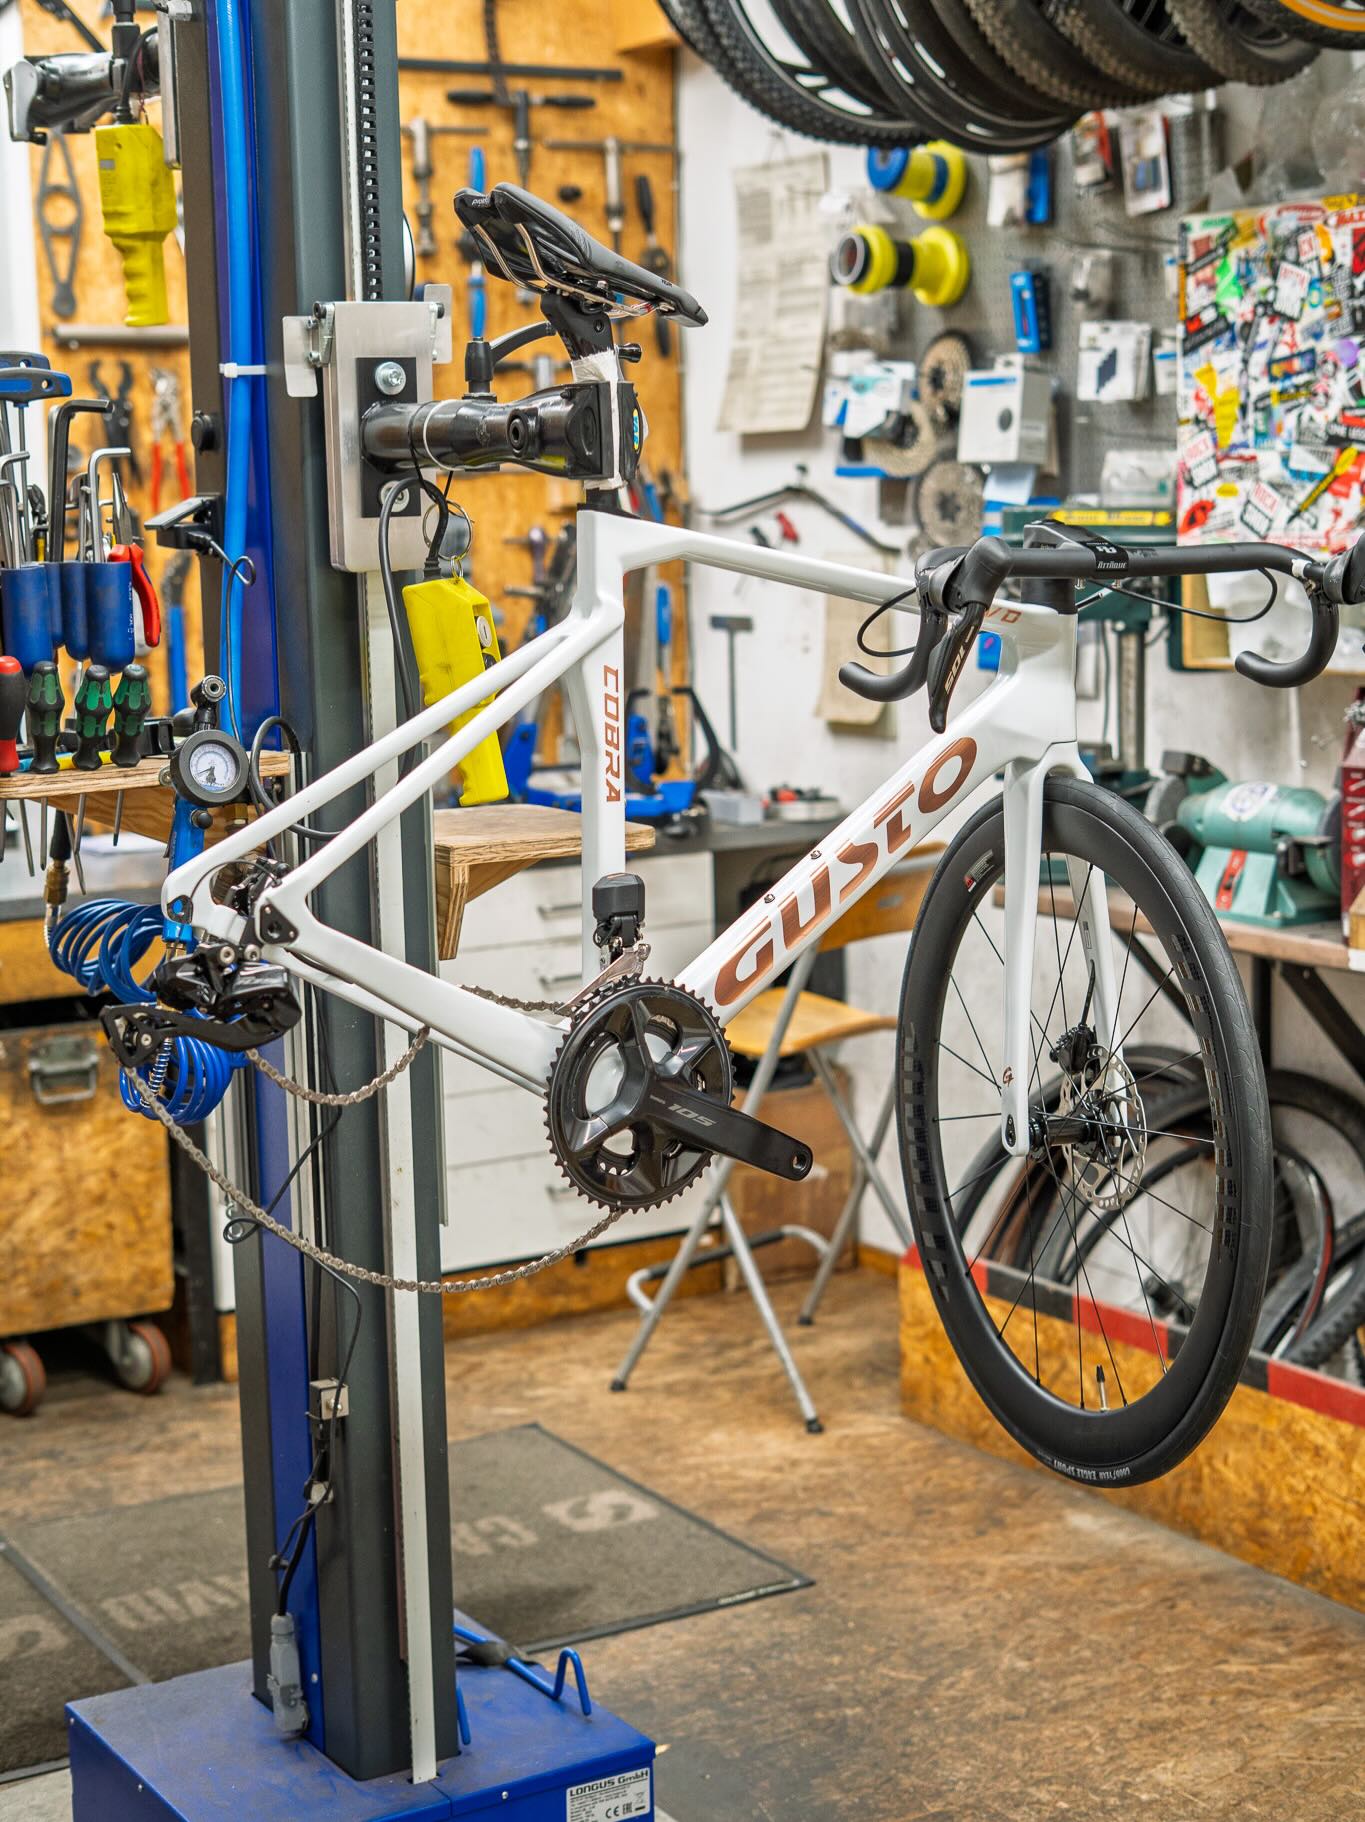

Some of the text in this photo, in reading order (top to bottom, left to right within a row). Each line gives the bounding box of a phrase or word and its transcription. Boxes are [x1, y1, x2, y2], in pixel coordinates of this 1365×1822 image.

[984, 607, 1022, 624] VO
[603, 664, 621, 803] COBRA
[714, 736, 978, 1007] GUSTO
[667, 1102, 718, 1128] 105
[1053, 1459, 1075, 1477] SPORT
[1075, 1467, 1098, 1481] EAGLE
[569, 1778, 616, 1797] LONGUS
[617, 1769, 649, 1785] GmbH
